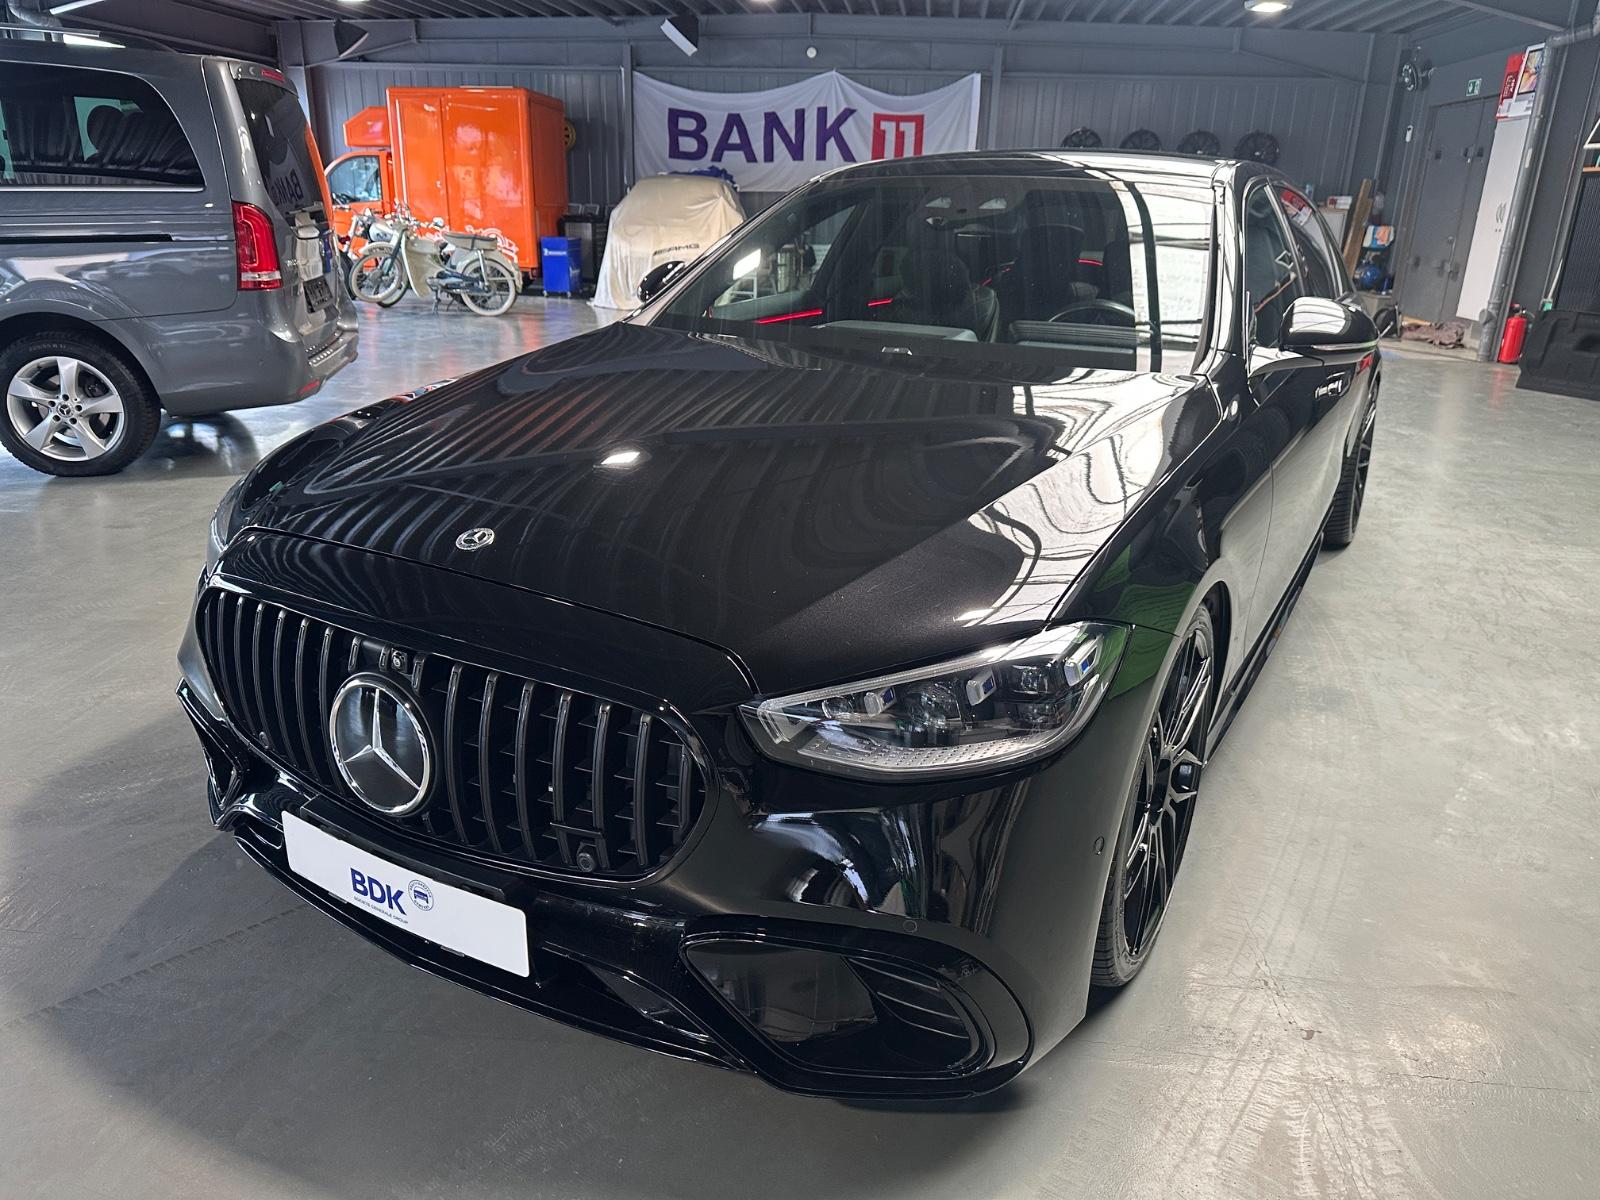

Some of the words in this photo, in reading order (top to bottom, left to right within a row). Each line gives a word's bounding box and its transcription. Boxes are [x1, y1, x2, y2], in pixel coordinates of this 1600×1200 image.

[667, 106, 857, 163] BANK
[876, 116, 920, 160] 11
[350, 867, 407, 916] BDK
